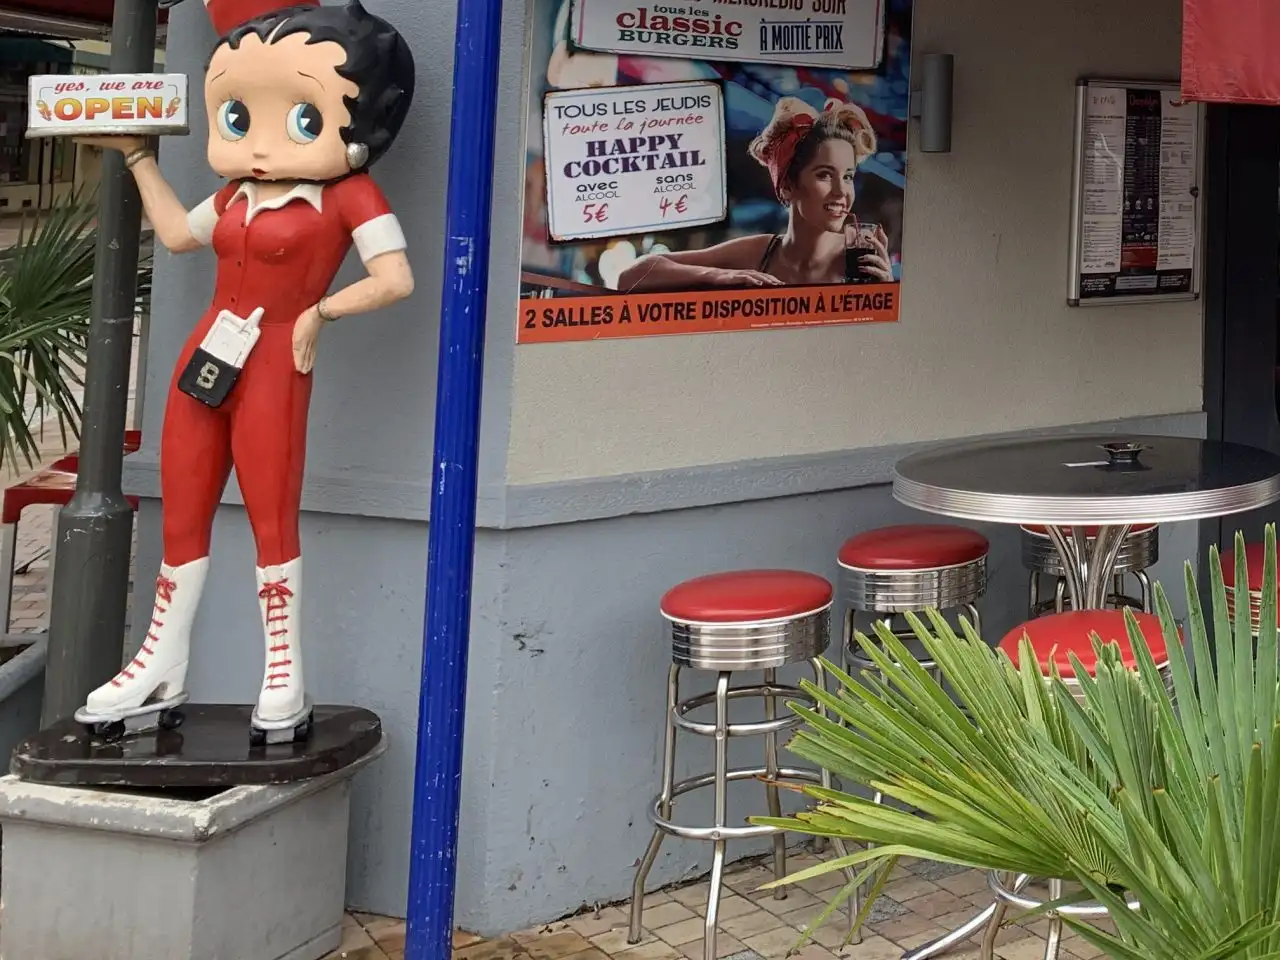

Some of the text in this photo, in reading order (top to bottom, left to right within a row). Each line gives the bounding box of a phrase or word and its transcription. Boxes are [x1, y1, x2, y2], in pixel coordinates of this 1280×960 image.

[653, 4, 709, 17] tous les
[616, 8, 743, 37] classic
[618, 29, 739, 50] BURGERS
[771, 18, 811, 50] MOITIÉ
[815, 24, 843, 50] PRIX
[99, 80, 126, 91] we
[131, 80, 164, 91] are
[53, 96, 163, 121] OPEN
[554, 95, 711, 119] TOUS LES JEUDIS
[561, 113, 704, 136] toute la journée
[586, 133, 684, 158] HAPPY
[563, 150, 706, 179] COCKTAIL
[576, 180, 618, 193] avec
[653, 182, 696, 193] ALCOOL
[655, 173, 693, 184] sans
[574, 191, 621, 202] ALCOOL
[582, 203, 609, 223] 5€
[524, 290, 893, 329] 2 SALLES À VOTRE DISPOSITION À L'ÉTAGE
